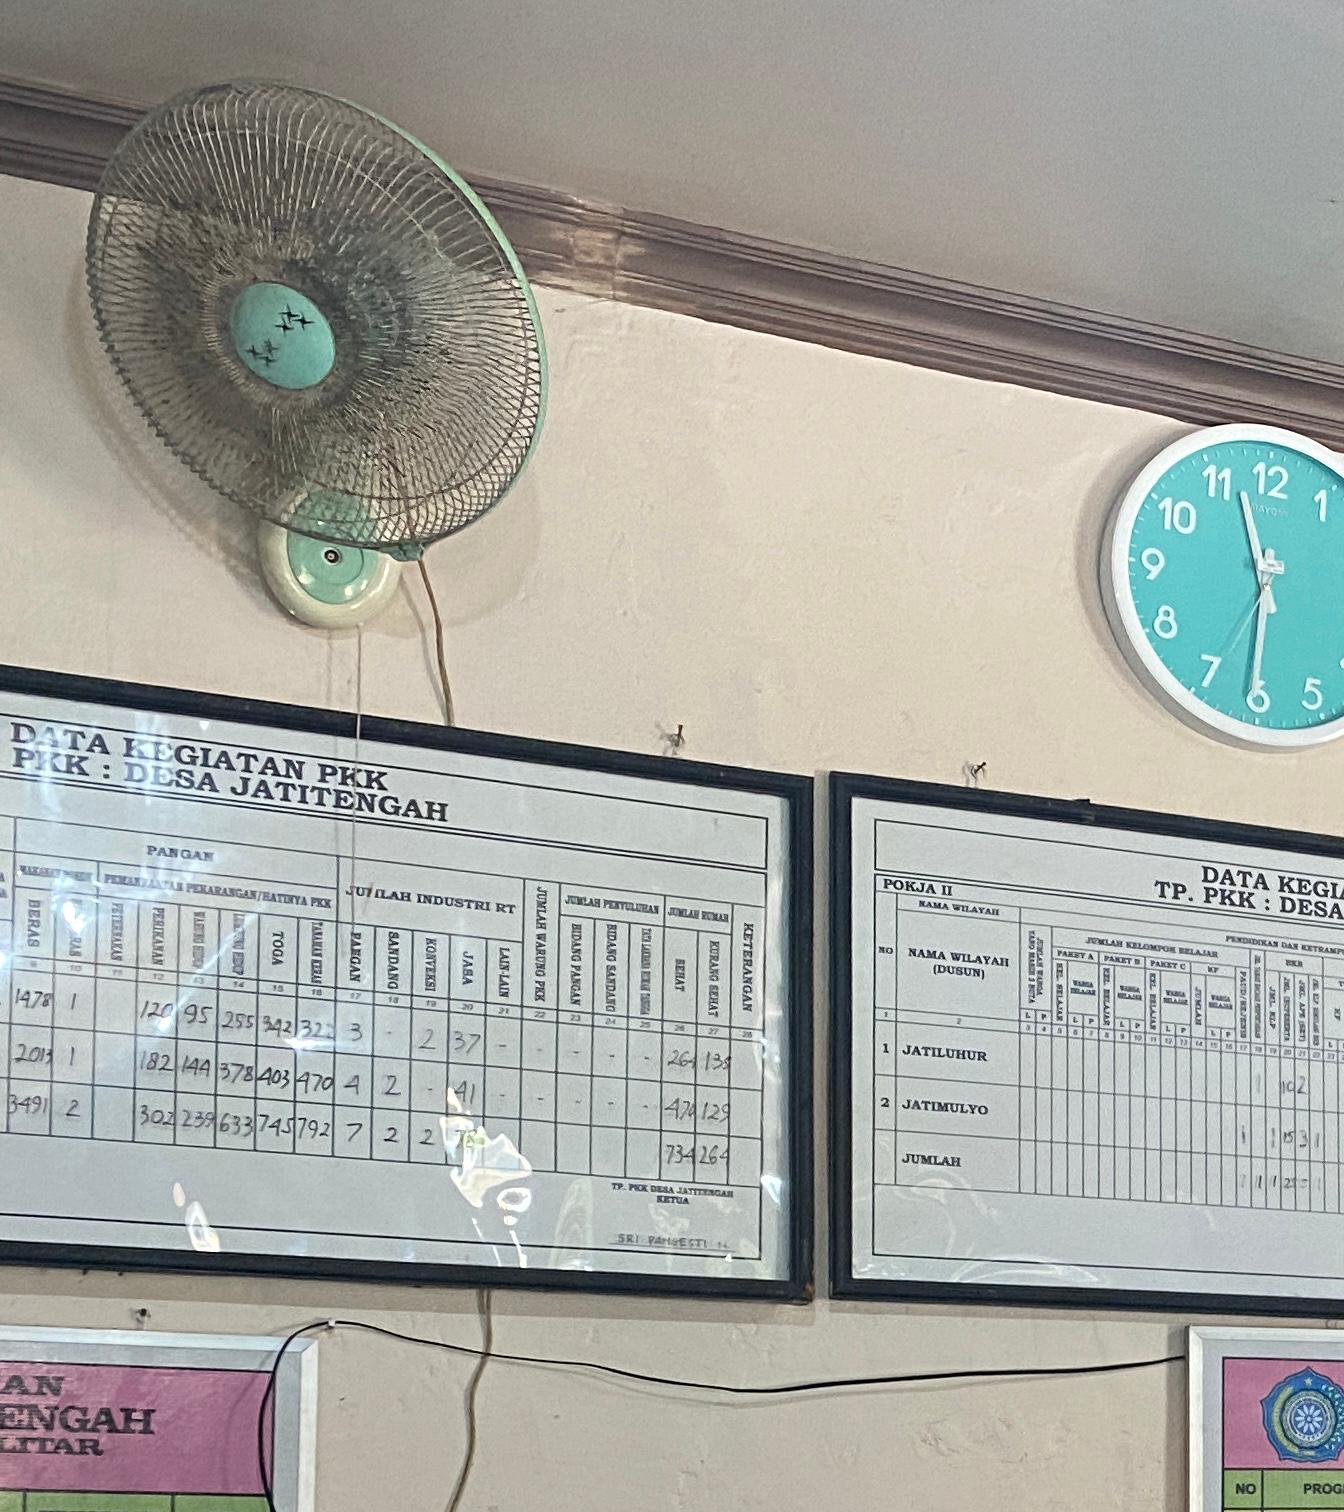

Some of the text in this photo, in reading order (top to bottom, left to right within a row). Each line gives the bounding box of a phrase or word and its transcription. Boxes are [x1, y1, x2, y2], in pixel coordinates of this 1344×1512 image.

[1202, 464, 1231, 500] 11
[1252, 462, 1289, 499] 12
[1158, 496, 1196, 534] 10
[1314, 489, 1327, 522] 1
[1141, 548, 1165, 580] 9
[1153, 605, 1178, 639] 8
[1201, 654, 1221, 688] 7
[1246, 679, 1270, 713] 6
[1301, 677, 1323, 710] 5
[11, 722, 389, 790] DATA KEGIATAN PKK
[13, 748, 449, 822] PKK DESA JATITENGAH
[147, 845, 215, 862] PANGAN
[883, 878, 952, 896] POKJA II
[1200, 865, 1270, 892] DATA
[417, 893, 491, 911] INDUSTRI
[496, 904, 516, 914] RT
[918, 900, 1000, 916] NAMA WILAYAH
[1154, 880, 1194, 902] TP.
[1203, 886, 1256, 909] PKK
[1279, 896, 1344, 921] DESA
[27, 899, 41, 948] BERAS
[152, 907, 165, 966] PERIKANAN
[272, 931, 284, 966] TOGA
[350, 931, 362, 983] PANGAN
[387, 931, 400, 990] SANDANG
[535, 886, 547, 1003] JUMLAH WARUNG PKK
[708, 940, 720, 982] KURANG
[878, 945, 893, 955] NO
[908, 948, 1009, 967] NAMA WILAYAH
[425, 937, 437, 992] KONVEKSI
[462, 951, 474, 986] JASA
[499, 946, 510, 998] LAIN-LAIN
[570, 923, 582, 1006] BIDANG PANGAN
[605, 923, 617, 1012] BIDANG SANDANG
[675, 959, 685, 992] SEHAT
[742, 922, 754, 1012] KETERANGAN
[933, 964, 985, 980] (DUSUN)
[184, 1004, 481, 1054] 95 255 3 2 37
[882, 1043, 988, 1062] 1 JATILUHUR
[140, 1052, 401, 1095] 182 378 403 470 2
[66, 1100, 435, 1145] 2 633 745 792 7 2 2
[880, 1097, 989, 1116] 2 JATIMULYO
[901, 1153, 962, 1168] JUMLAH
[0, 1374, 65, 1396] AN
[0, 1403, 156, 1434] ENGAH
[1235, 1482, 1257, 1496] NO
